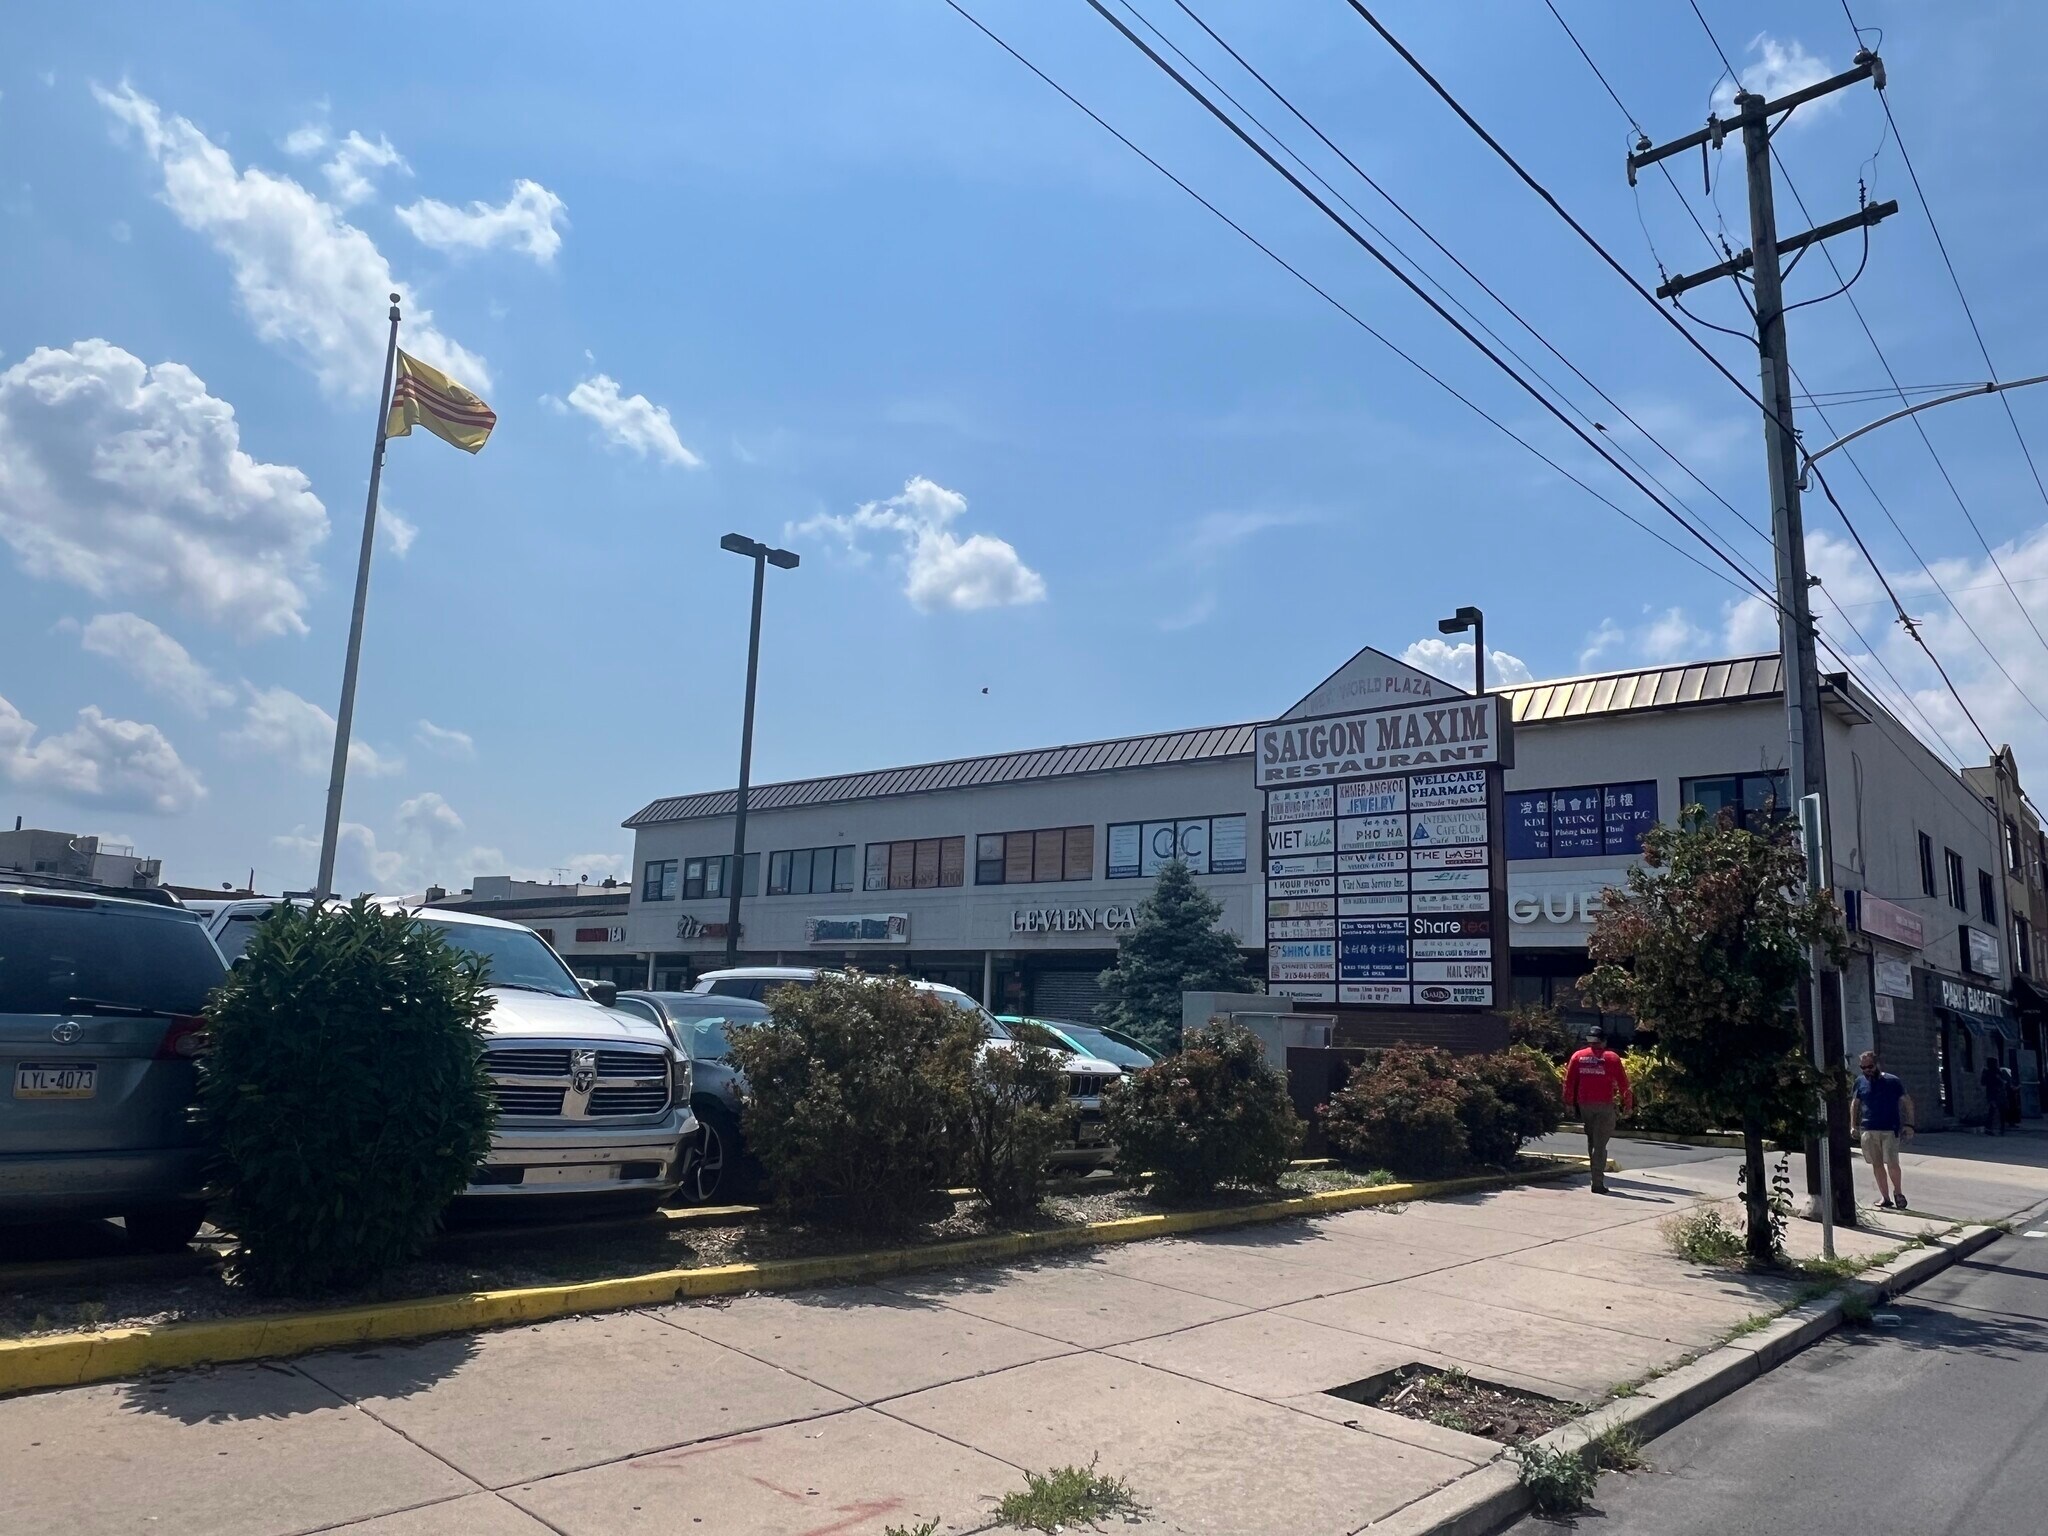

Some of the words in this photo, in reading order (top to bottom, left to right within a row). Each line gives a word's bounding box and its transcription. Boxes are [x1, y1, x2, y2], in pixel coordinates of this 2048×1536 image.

[1385, 677, 1431, 697] PLAZA
[1264, 720, 1367, 764] SAIGON
[1376, 705, 1489, 751] MAXIM
[1265, 745, 1489, 780] RESTAURANT
[1413, 771, 1484, 786] WELLCARE
[1412, 782, 1486, 798] PHARMACY
[1347, 795, 1395, 813] JEWELRY
[1423, 812, 1486, 824] INTERNATIONAL
[1524, 818, 1545, 827] KIM
[1558, 815, 1595, 825] YEUNG
[1604, 812, 1631, 822] LING
[1459, 823, 1481, 834] CLUB
[1269, 830, 1302, 850] VIET
[1414, 851, 1440, 859] THE
[1445, 849, 1483, 859] LASH
[1279, 880, 1301, 889] HOUR
[1304, 879, 1330, 887] PHOTO
[1293, 901, 1328, 912] JUNTOS
[1282, 945, 1310, 957] SHING
[1313, 945, 1332, 956] KEE
[1447, 965, 1462, 978] NAIL
[1465, 965, 1489, 978] SUPPLY
